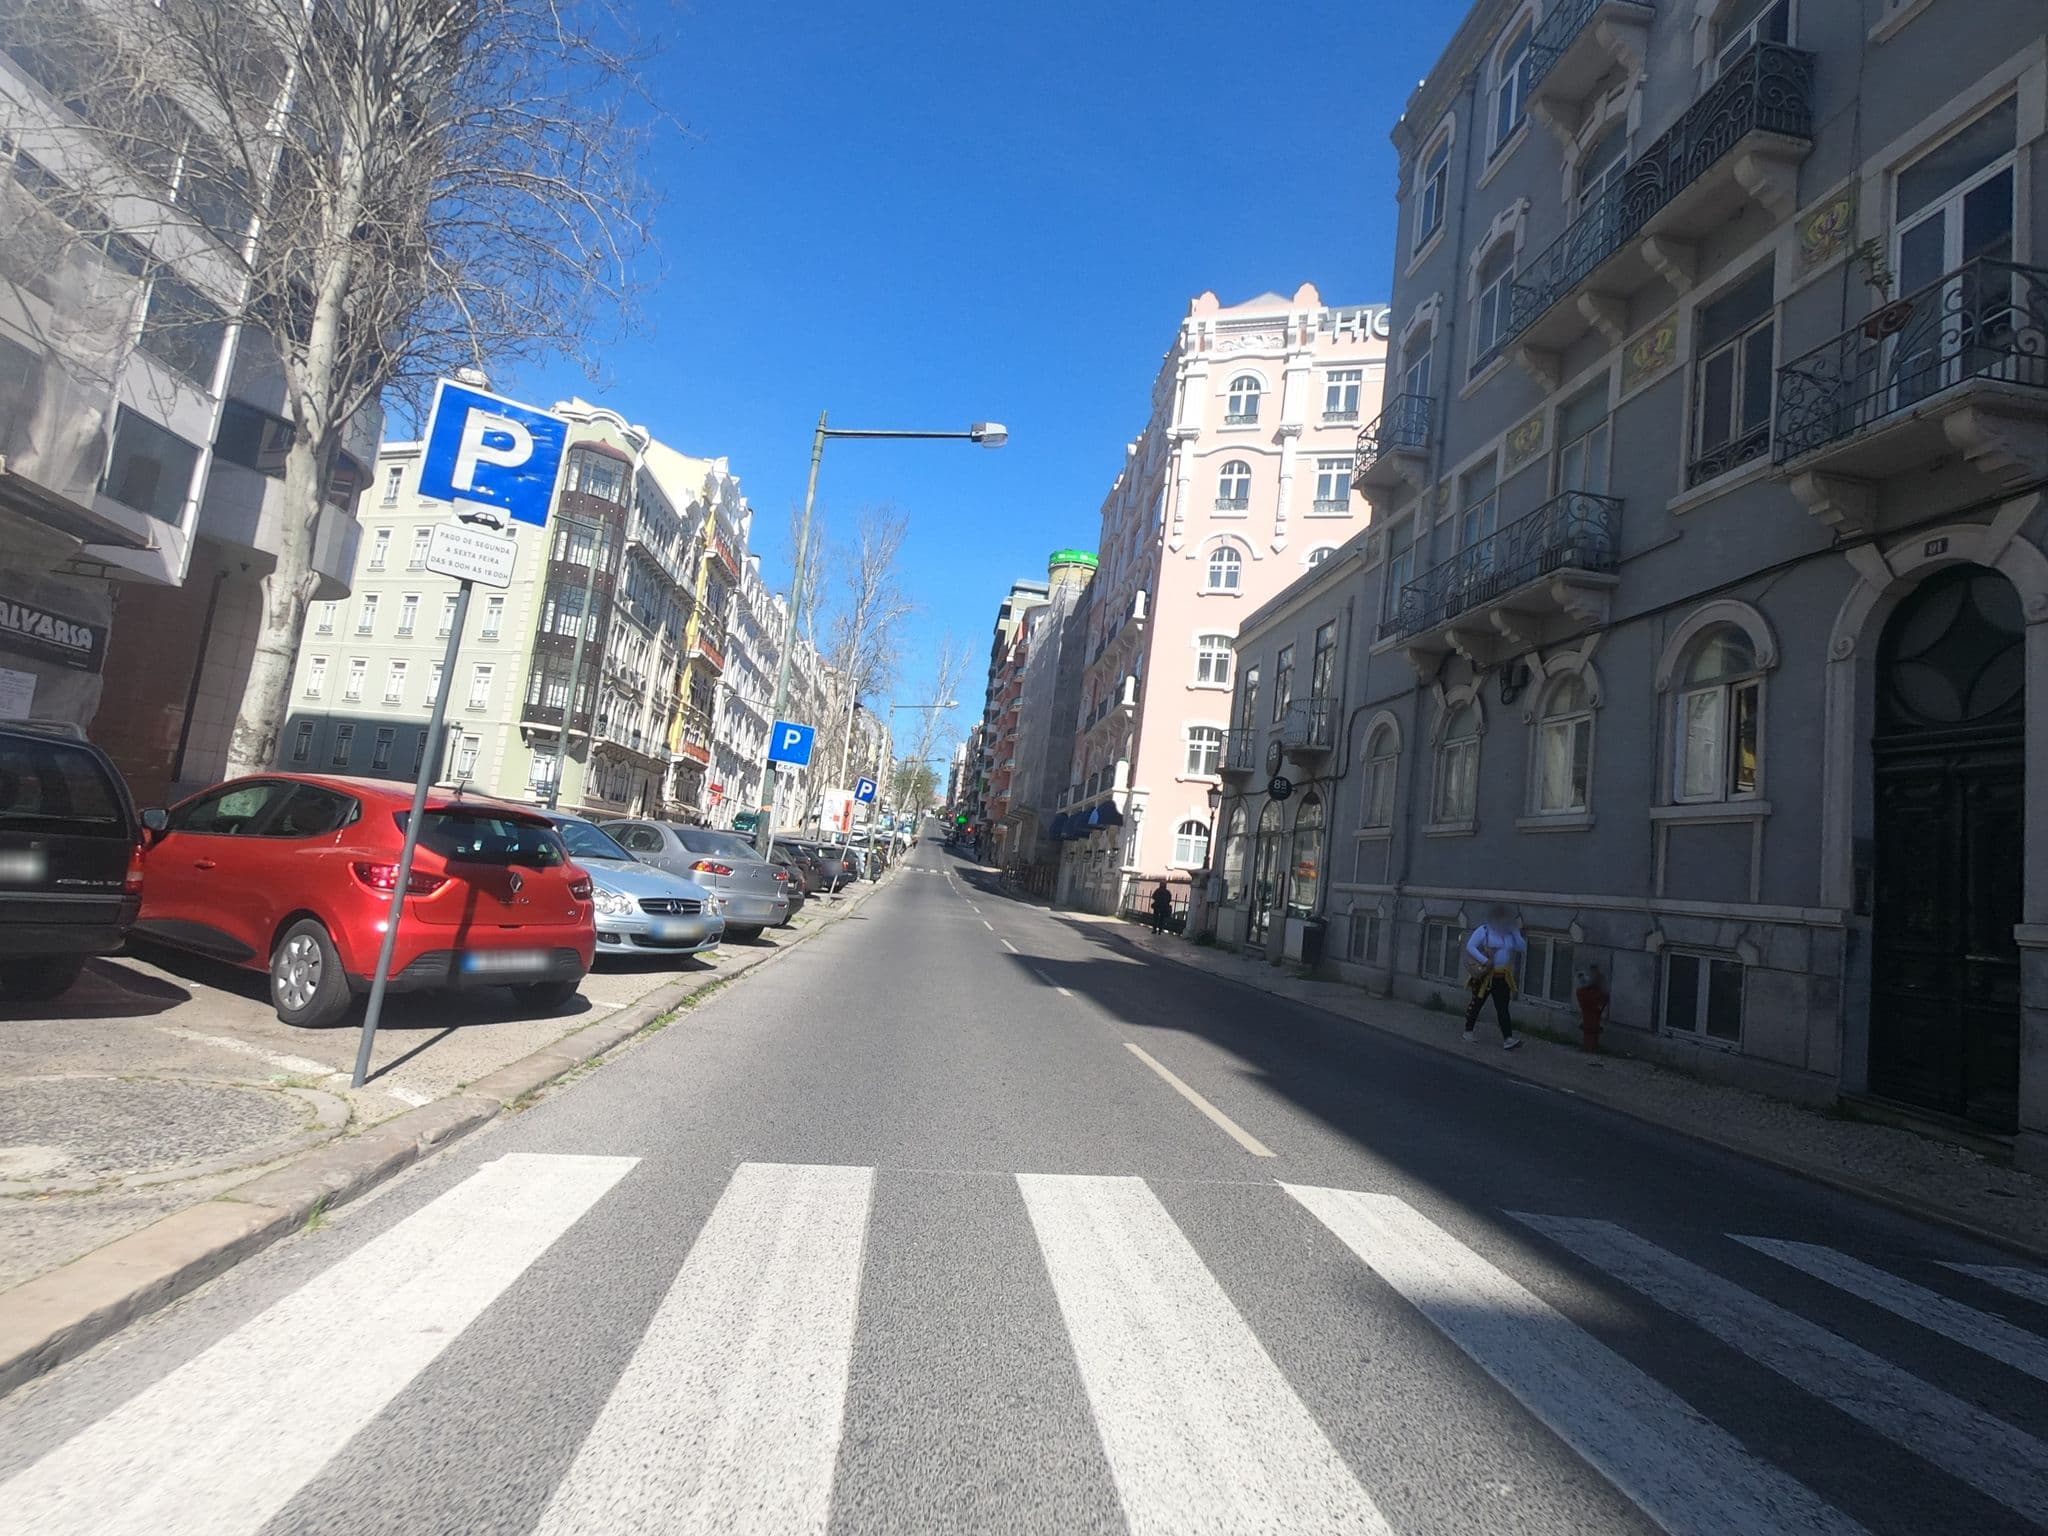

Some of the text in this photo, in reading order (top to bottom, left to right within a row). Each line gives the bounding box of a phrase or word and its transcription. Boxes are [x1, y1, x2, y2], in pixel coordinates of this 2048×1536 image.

[451, 407, 534, 492] P
[440, 531, 510, 554] PAGO DE SEGUNDA
[430, 556, 446, 565] DAS
[454, 548, 476, 559] SEXTA
[478, 554, 499, 565] FEIRA
[783, 728, 801, 750] P
[858, 781, 873, 798] P
